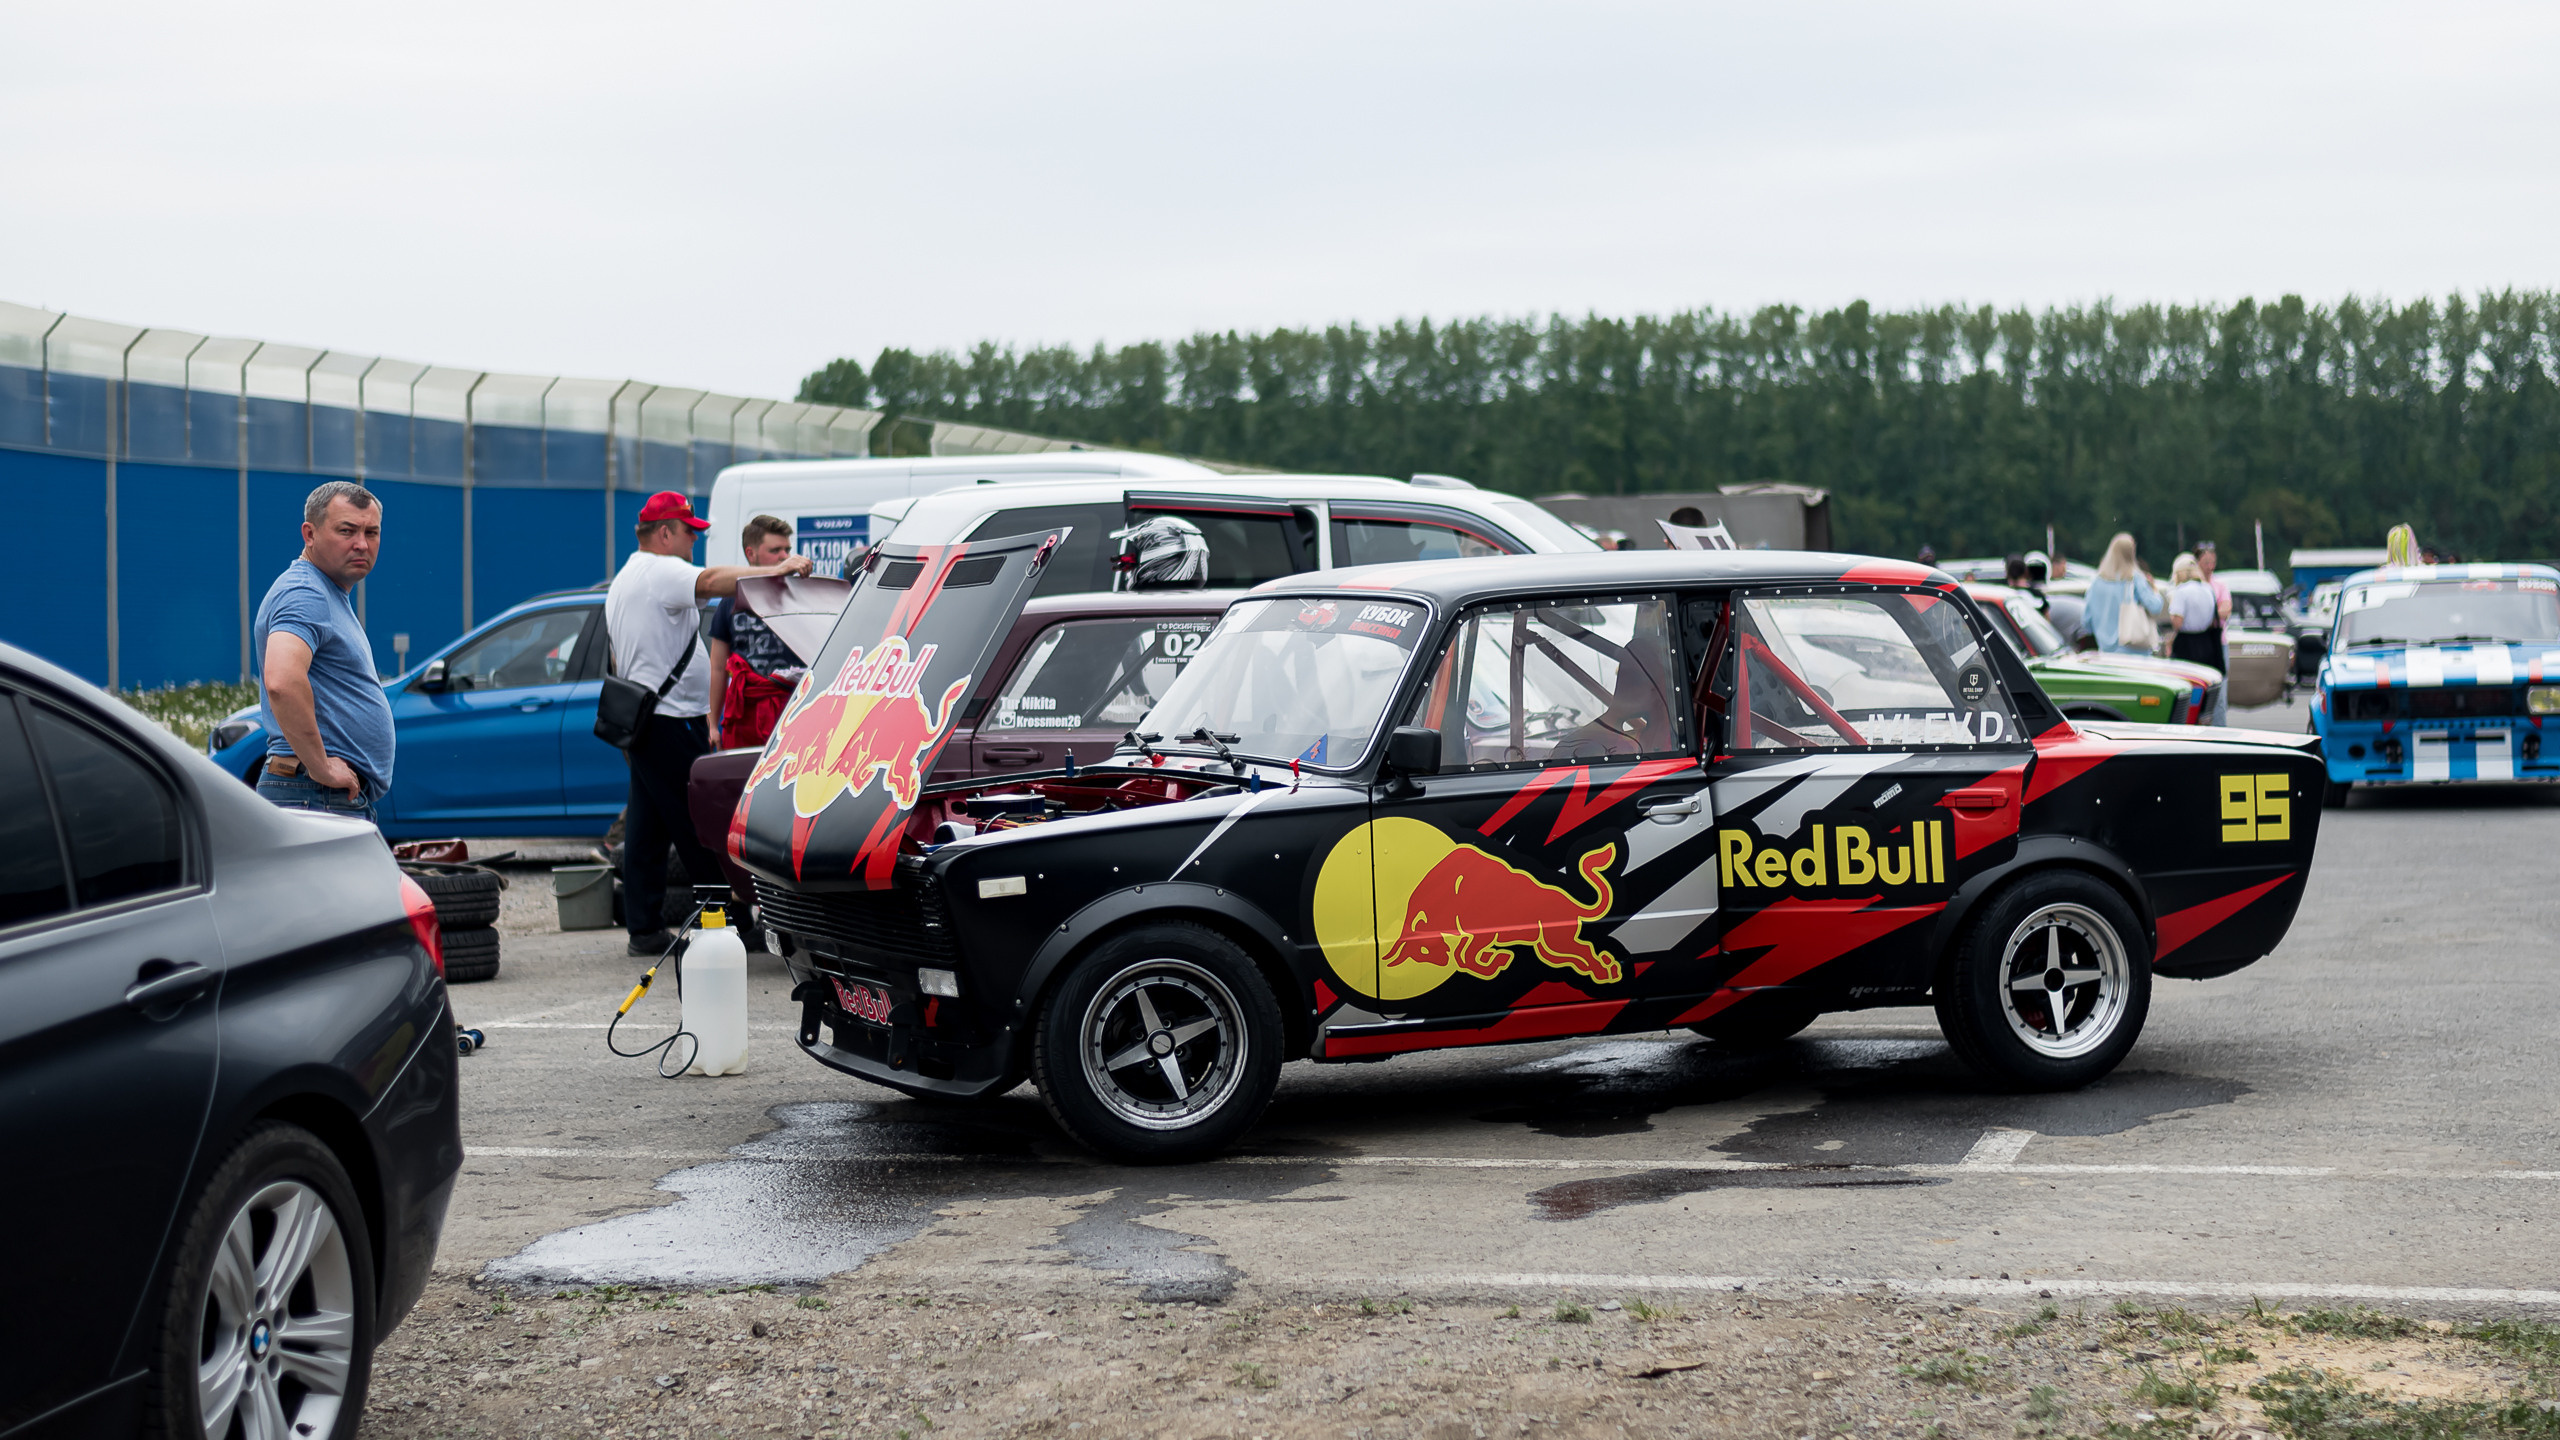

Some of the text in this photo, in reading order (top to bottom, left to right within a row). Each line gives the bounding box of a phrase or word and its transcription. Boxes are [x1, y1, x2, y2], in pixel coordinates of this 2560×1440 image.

[814, 518, 853, 529] VOLVO
[802, 540, 850, 559] ACTION
[1357, 604, 1415, 628] КУБОК
[1347, 620, 1402, 639] КЛАССИКИ
[828, 643, 891, 697] Red
[867, 644, 938, 698] Bull
[1001, 696, 1057, 711] Tur Nikita
[1016, 714, 1082, 728] Krossmen26
[2220, 773, 2290, 842] 95
[1719, 820, 1945, 888] Red Bull
[829, 975, 893, 1027] Red Bull
